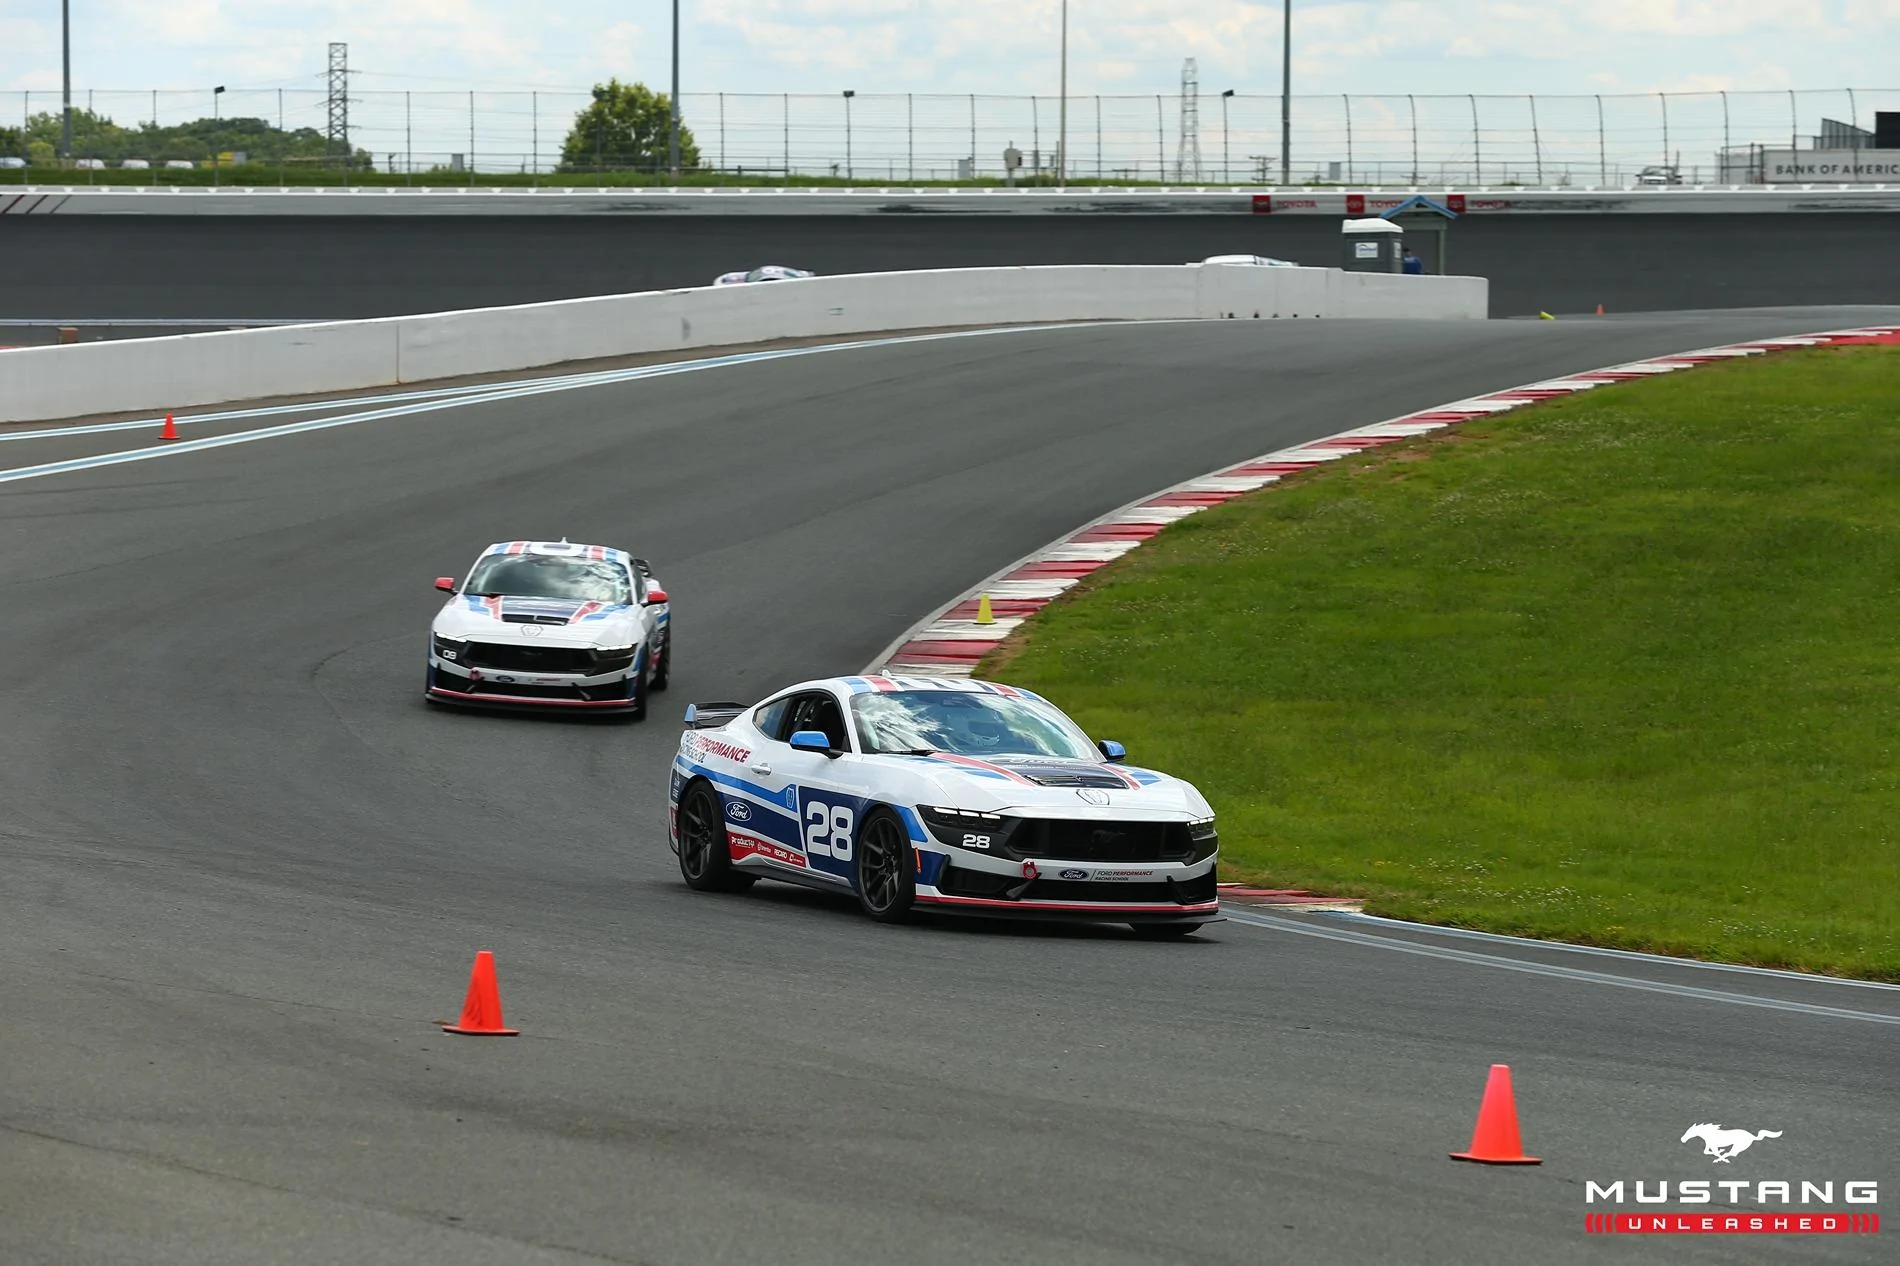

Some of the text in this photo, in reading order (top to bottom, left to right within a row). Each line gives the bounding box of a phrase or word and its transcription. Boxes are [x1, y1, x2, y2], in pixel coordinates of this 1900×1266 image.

[1775, 164, 1816, 175] BANK
[1820, 164, 1838, 175] OF
[1276, 199, 1318, 209] TOYOTA
[695, 735, 751, 763] PERFORMANCE
[806, 800, 854, 862] 28
[962, 833, 990, 849] 28
